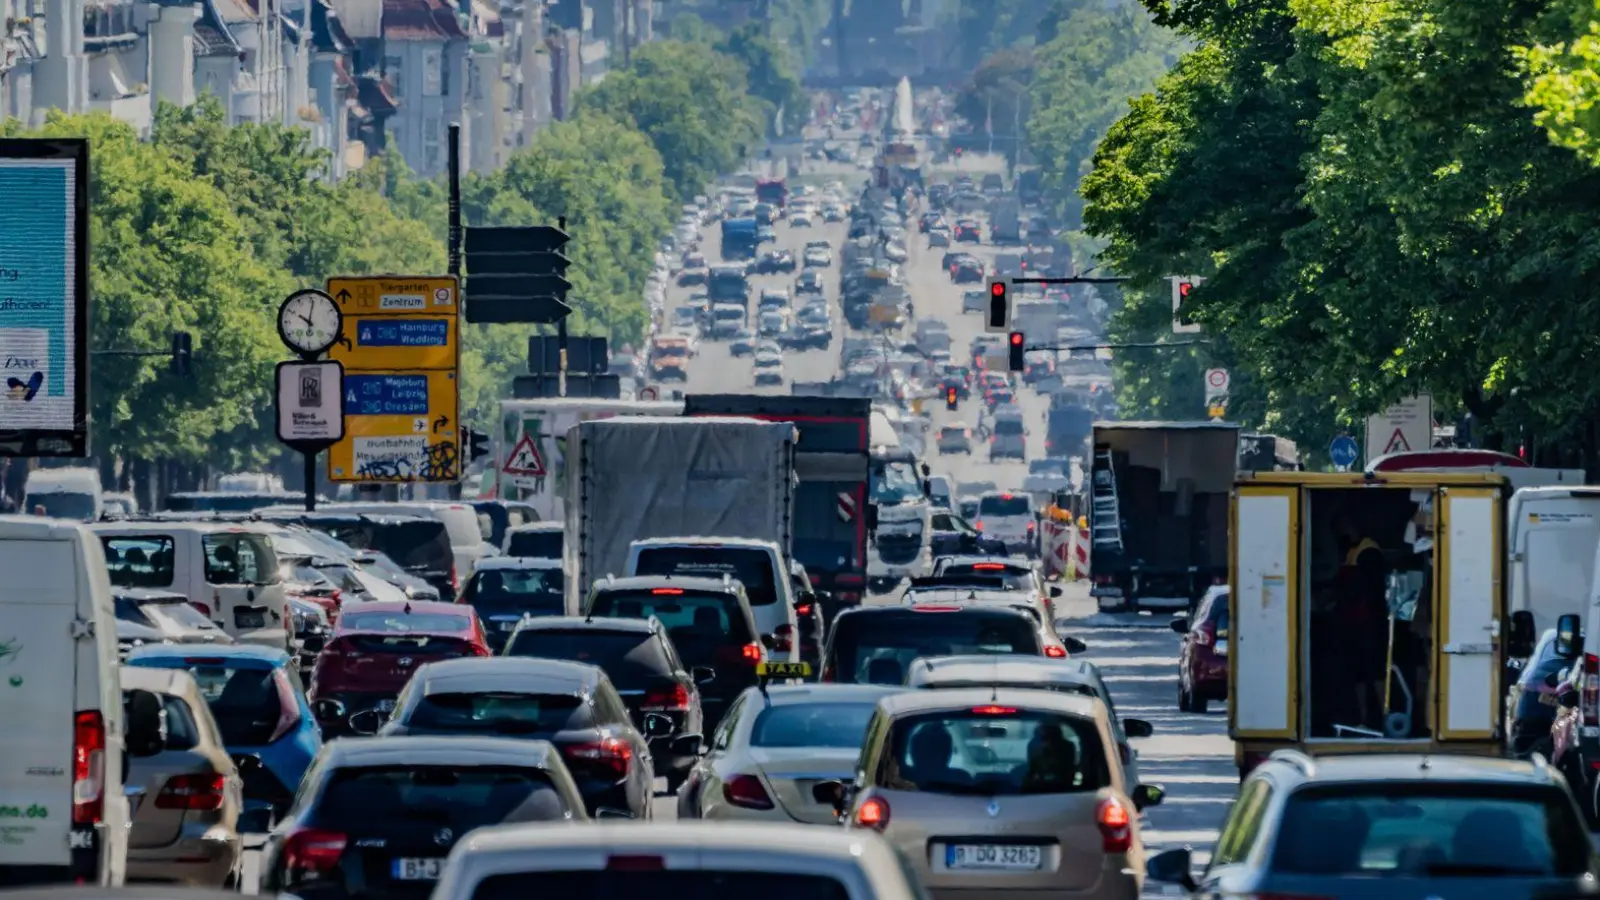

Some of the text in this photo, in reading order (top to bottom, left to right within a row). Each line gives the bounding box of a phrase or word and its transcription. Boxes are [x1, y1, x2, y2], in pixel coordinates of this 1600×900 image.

[380, 283, 430, 294] Tiergarten
[382, 297, 424, 307] Zentrum
[399, 323, 445, 333] Hamburg
[400, 335, 444, 345] Wedding
[385, 378, 426, 388] Magdeburg
[391, 390, 426, 399] Leipzig
[384, 402, 426, 411] Dresden
[767, 663, 804, 673] TAXI
[406, 861, 418, 877] B
